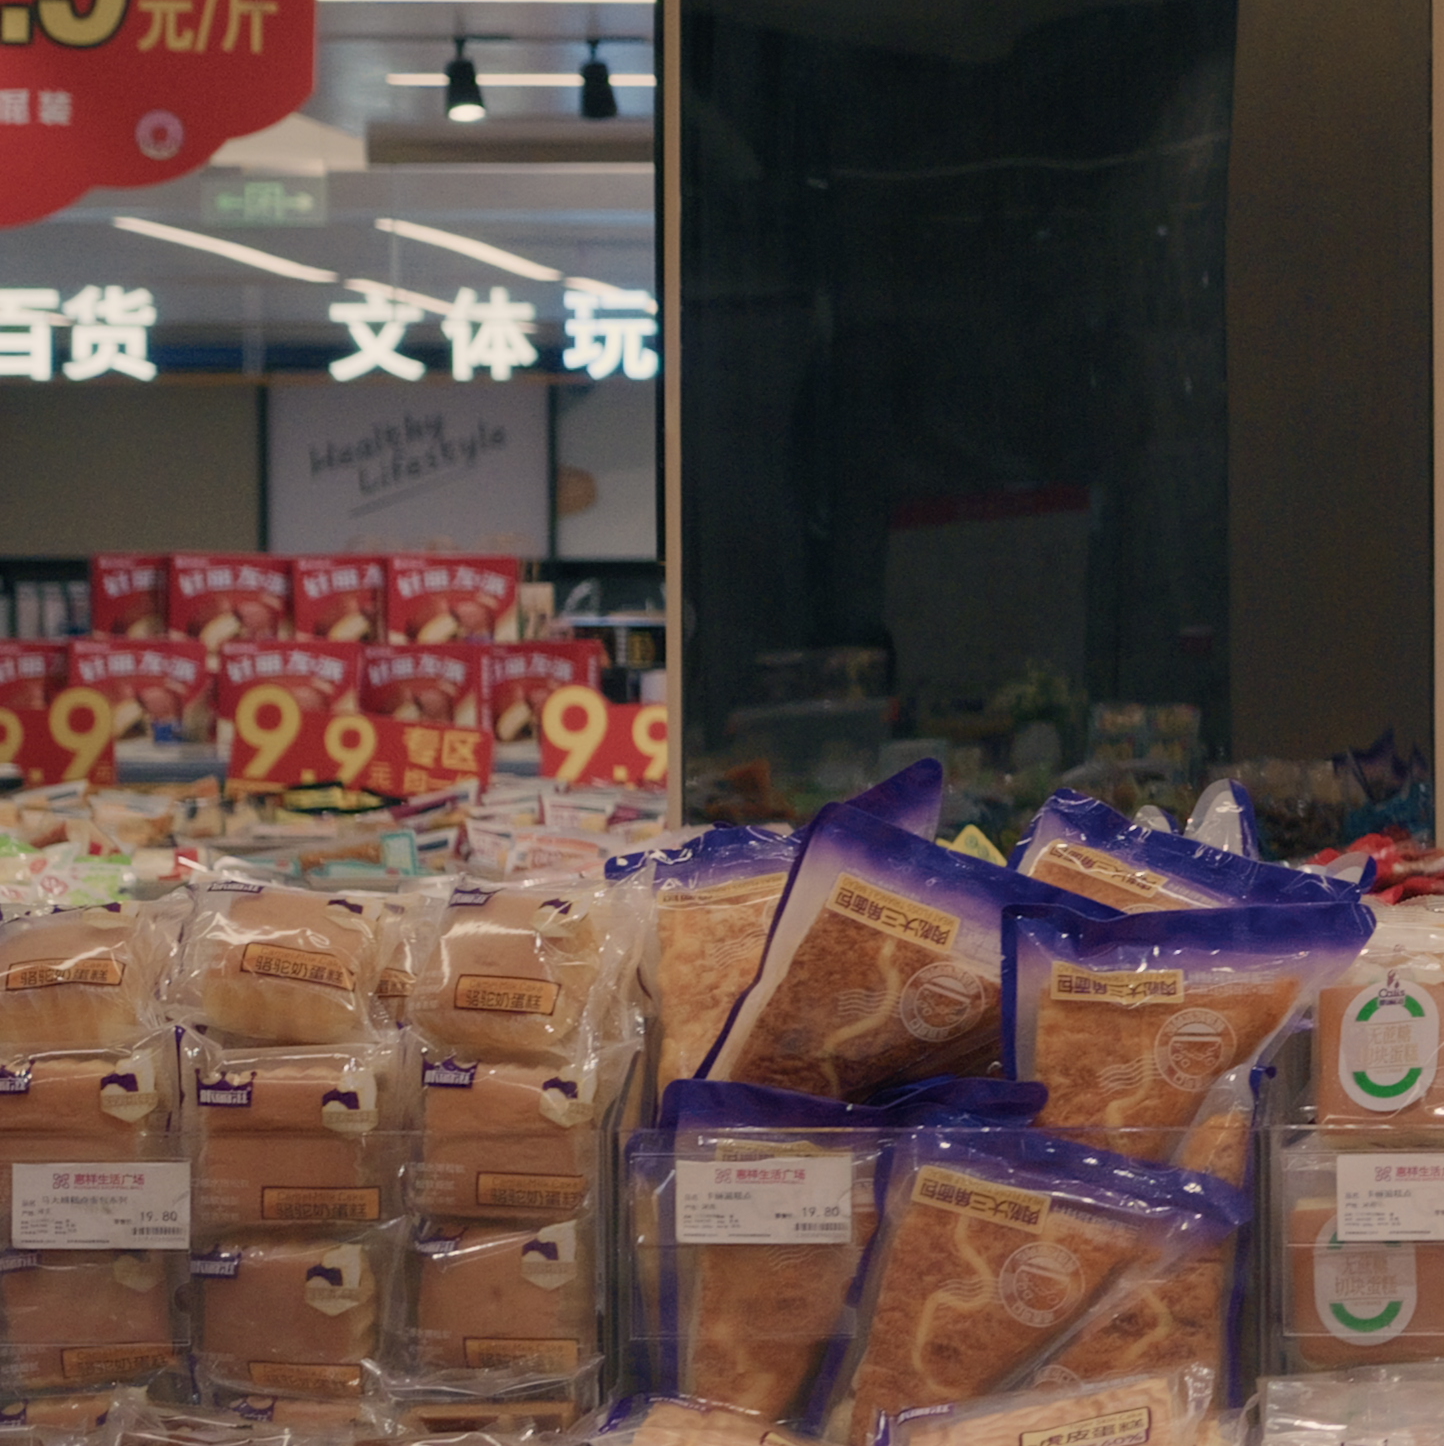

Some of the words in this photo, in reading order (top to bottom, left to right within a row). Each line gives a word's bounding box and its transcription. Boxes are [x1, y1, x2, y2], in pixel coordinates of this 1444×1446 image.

[235, 685, 378, 785] 9.9
[834, 886, 952, 947] 肉松大三角面包
[254, 955, 346, 987] 骆驼奶蛋糕
[73, 1172, 145, 1187] 惠祥生活广场
[735, 1168, 806, 1181] 惠祥生活广场
[801, 1207, 841, 1218] 19.80
[918, 1177, 1041, 1228] 肉松大三角面包
[140, 1211, 179, 1223] 19.80
[1333, 1273, 1398, 1298] 切块蛋糕
